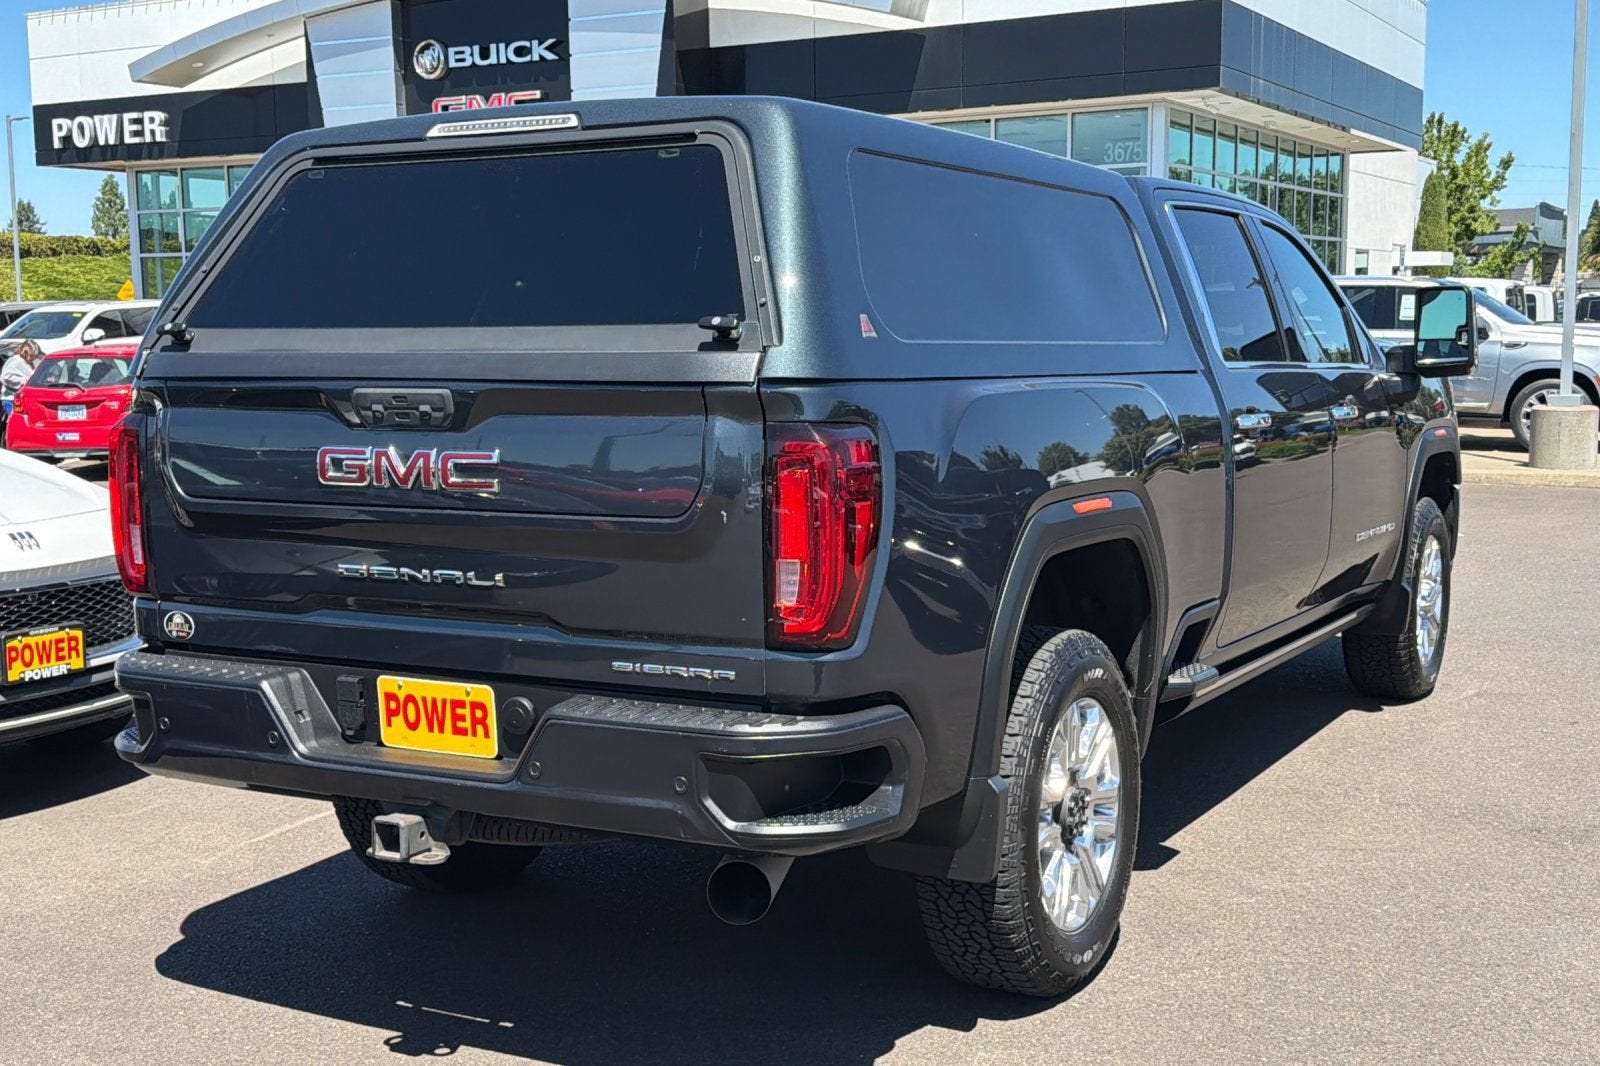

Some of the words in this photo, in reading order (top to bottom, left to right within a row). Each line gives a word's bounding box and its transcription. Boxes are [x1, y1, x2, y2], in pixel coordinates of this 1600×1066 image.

[448, 38, 559, 68] BUICK
[51, 110, 168, 149] POWER
[1103, 141, 1142, 163] 3675
[316, 445, 501, 493] GMC
[6, 635, 81, 671] POWER
[24, 664, 68, 682] POWER
[611, 661, 736, 681] SIERRA
[384, 692, 490, 739] POWER
